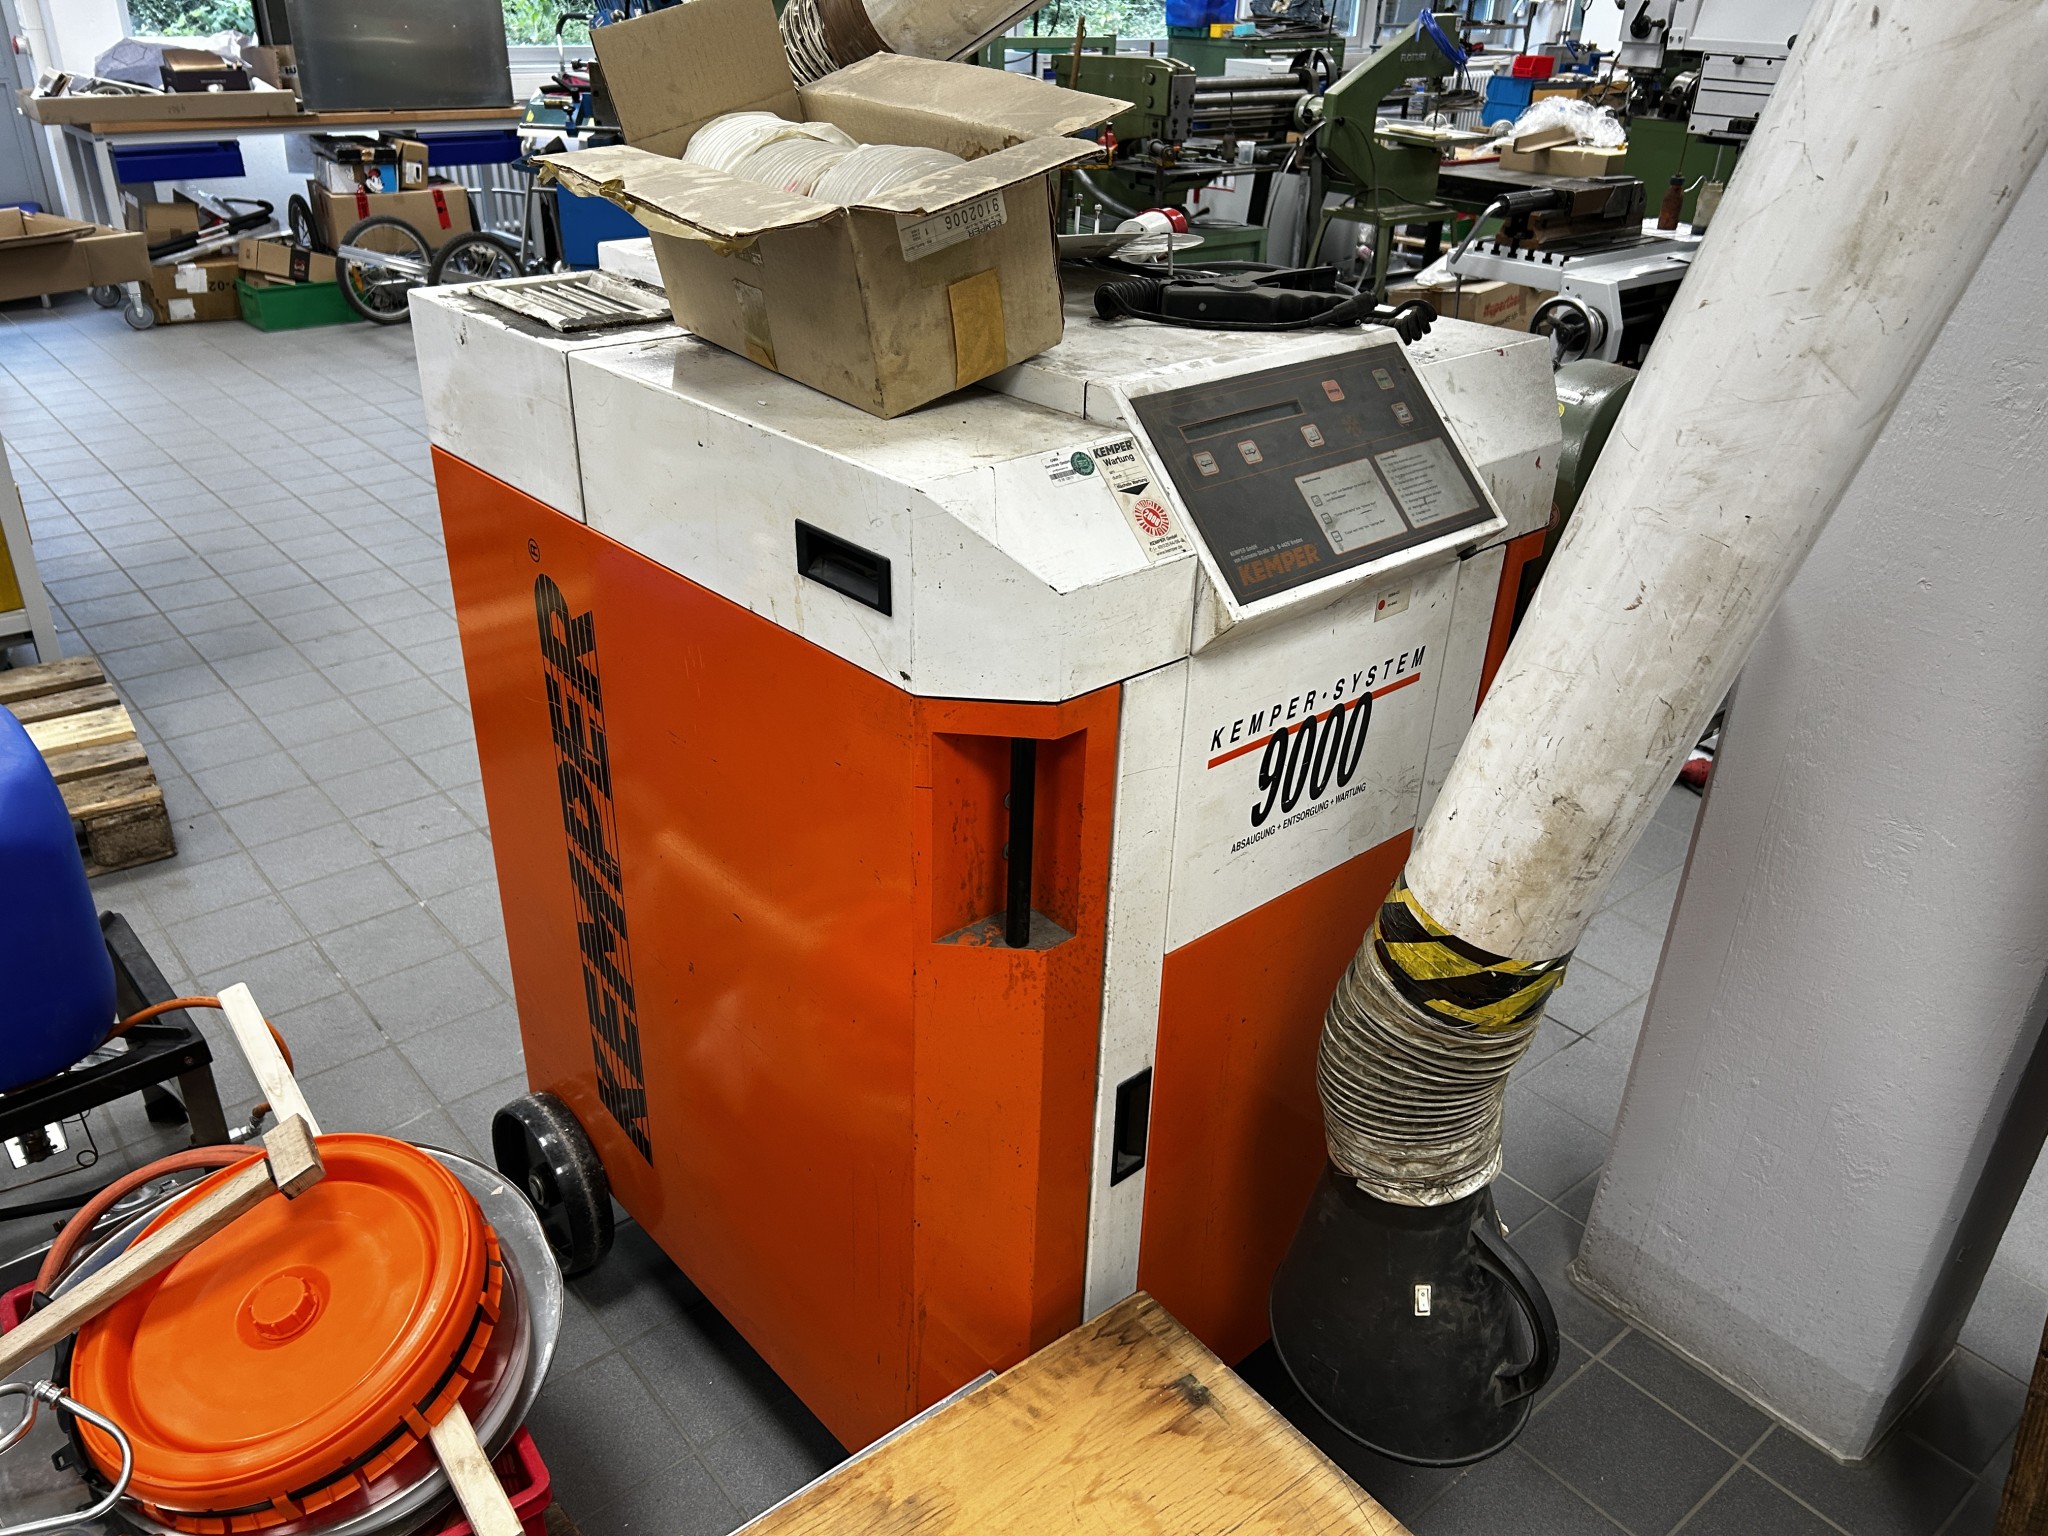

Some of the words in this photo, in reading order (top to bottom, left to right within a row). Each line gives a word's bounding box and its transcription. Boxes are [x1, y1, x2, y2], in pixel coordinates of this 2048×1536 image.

[944, 198, 1000, 230] 9102006
[968, 218, 1003, 238] KEMPER
[1093, 439, 1134, 459] KEMPER
[1102, 453, 1136, 467] Wartung
[1238, 543, 1321, 586] KEMPER
[1250, 691, 1373, 828] 9000
[1230, 824, 1276, 854] ABSAUGUNG
[1282, 799, 1329, 830] ENTSORGUNG
[1335, 782, 1367, 804] WARTUNG
[533, 571, 654, 1169] KEMPER
